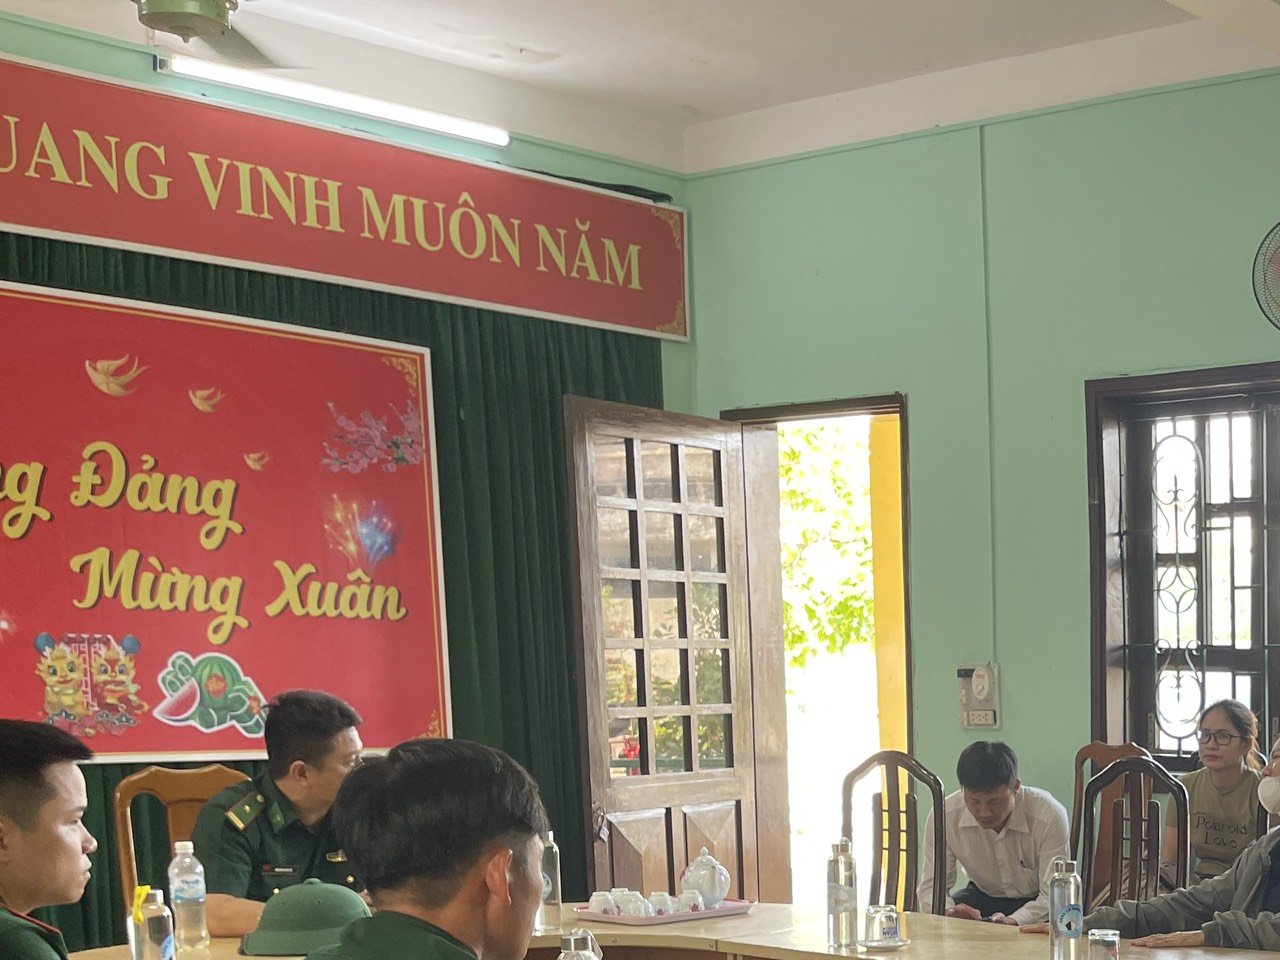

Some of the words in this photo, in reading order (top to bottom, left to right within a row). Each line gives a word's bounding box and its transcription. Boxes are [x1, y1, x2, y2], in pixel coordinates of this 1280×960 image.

[188, 151, 345, 233] VINH
[357, 186, 521, 268] MUÔN
[534, 217, 644, 290] NĂM
[70, 441, 244, 550] Đảng
[70, 547, 249, 645] Mừng
[264, 560, 407, 621] Xuân
